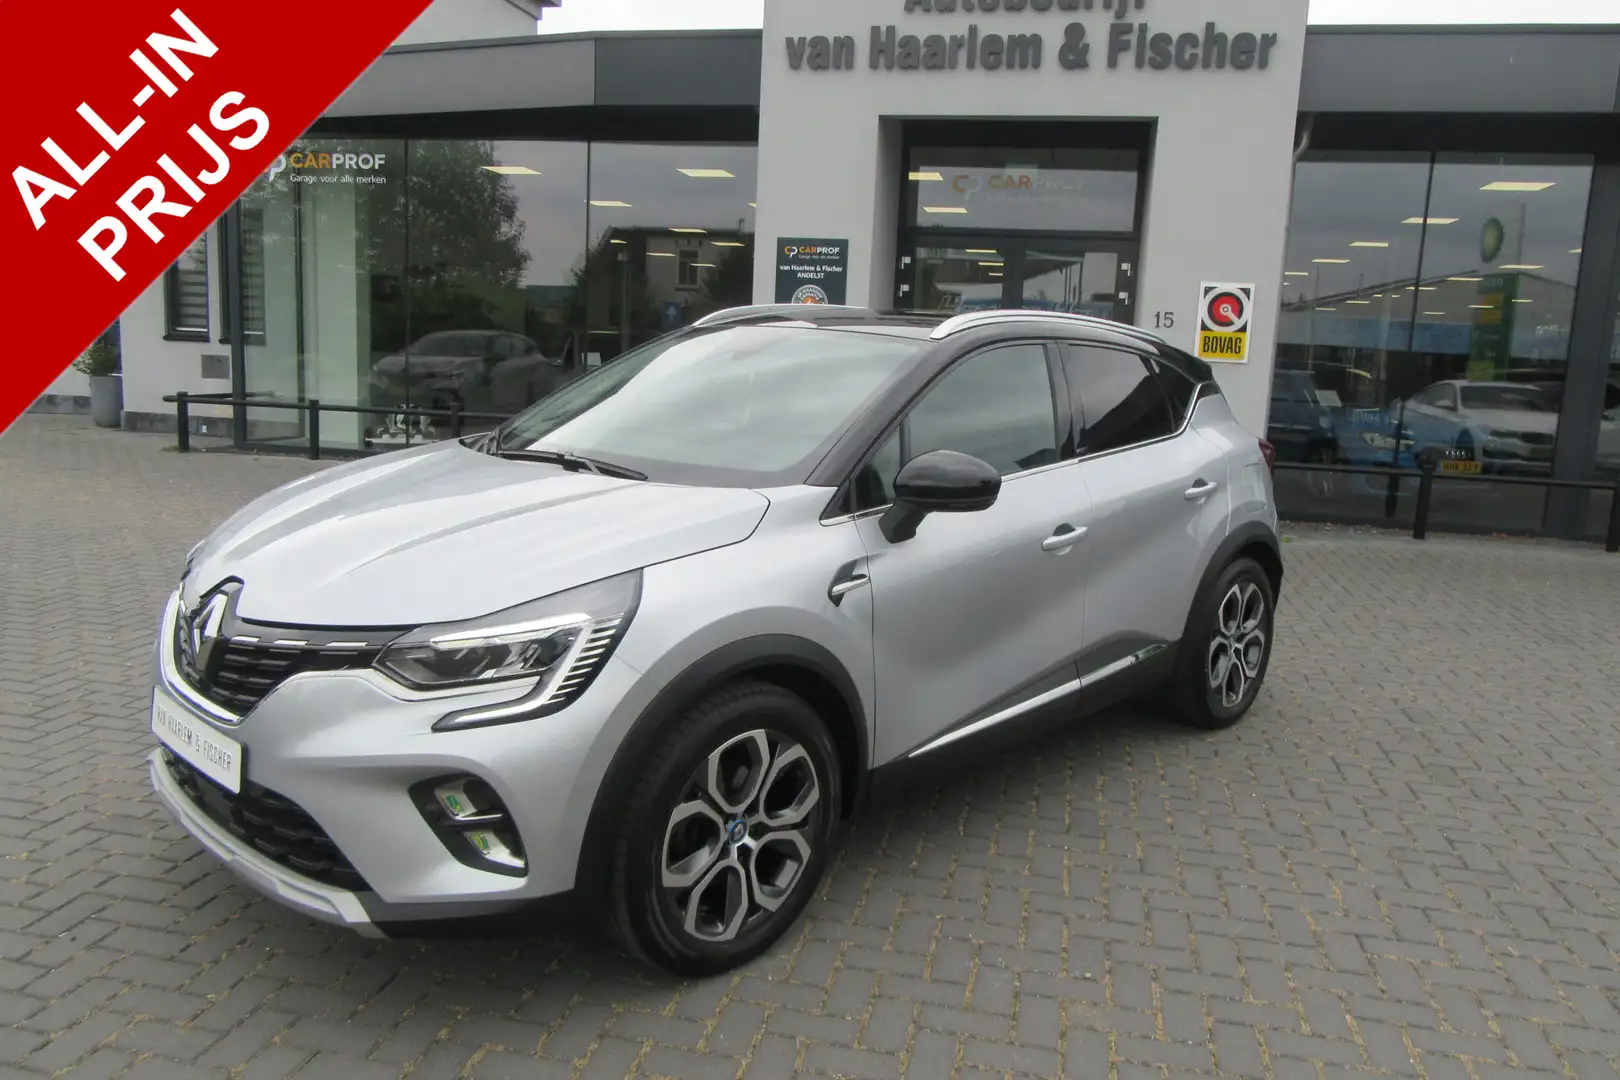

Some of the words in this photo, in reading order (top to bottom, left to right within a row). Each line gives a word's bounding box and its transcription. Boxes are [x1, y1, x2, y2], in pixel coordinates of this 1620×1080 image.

[785, 36, 855, 70] van
[869, 24, 1042, 71] Haarlem
[1058, 22, 1090, 70] &
[1106, 22, 1277, 70] Fischer
[290, 152, 386, 170] CARPROF
[290, 173, 318, 184] Garage
[320, 175, 338, 183] voor
[340, 174, 354, 183] alle
[356, 175, 387, 184] merken
[799, 246, 840, 254] CARPROF
[1154, 311, 1174, 328] 15
[1202, 336, 1242, 354] BOVAG
[203, 740, 232, 773] FISCHER
